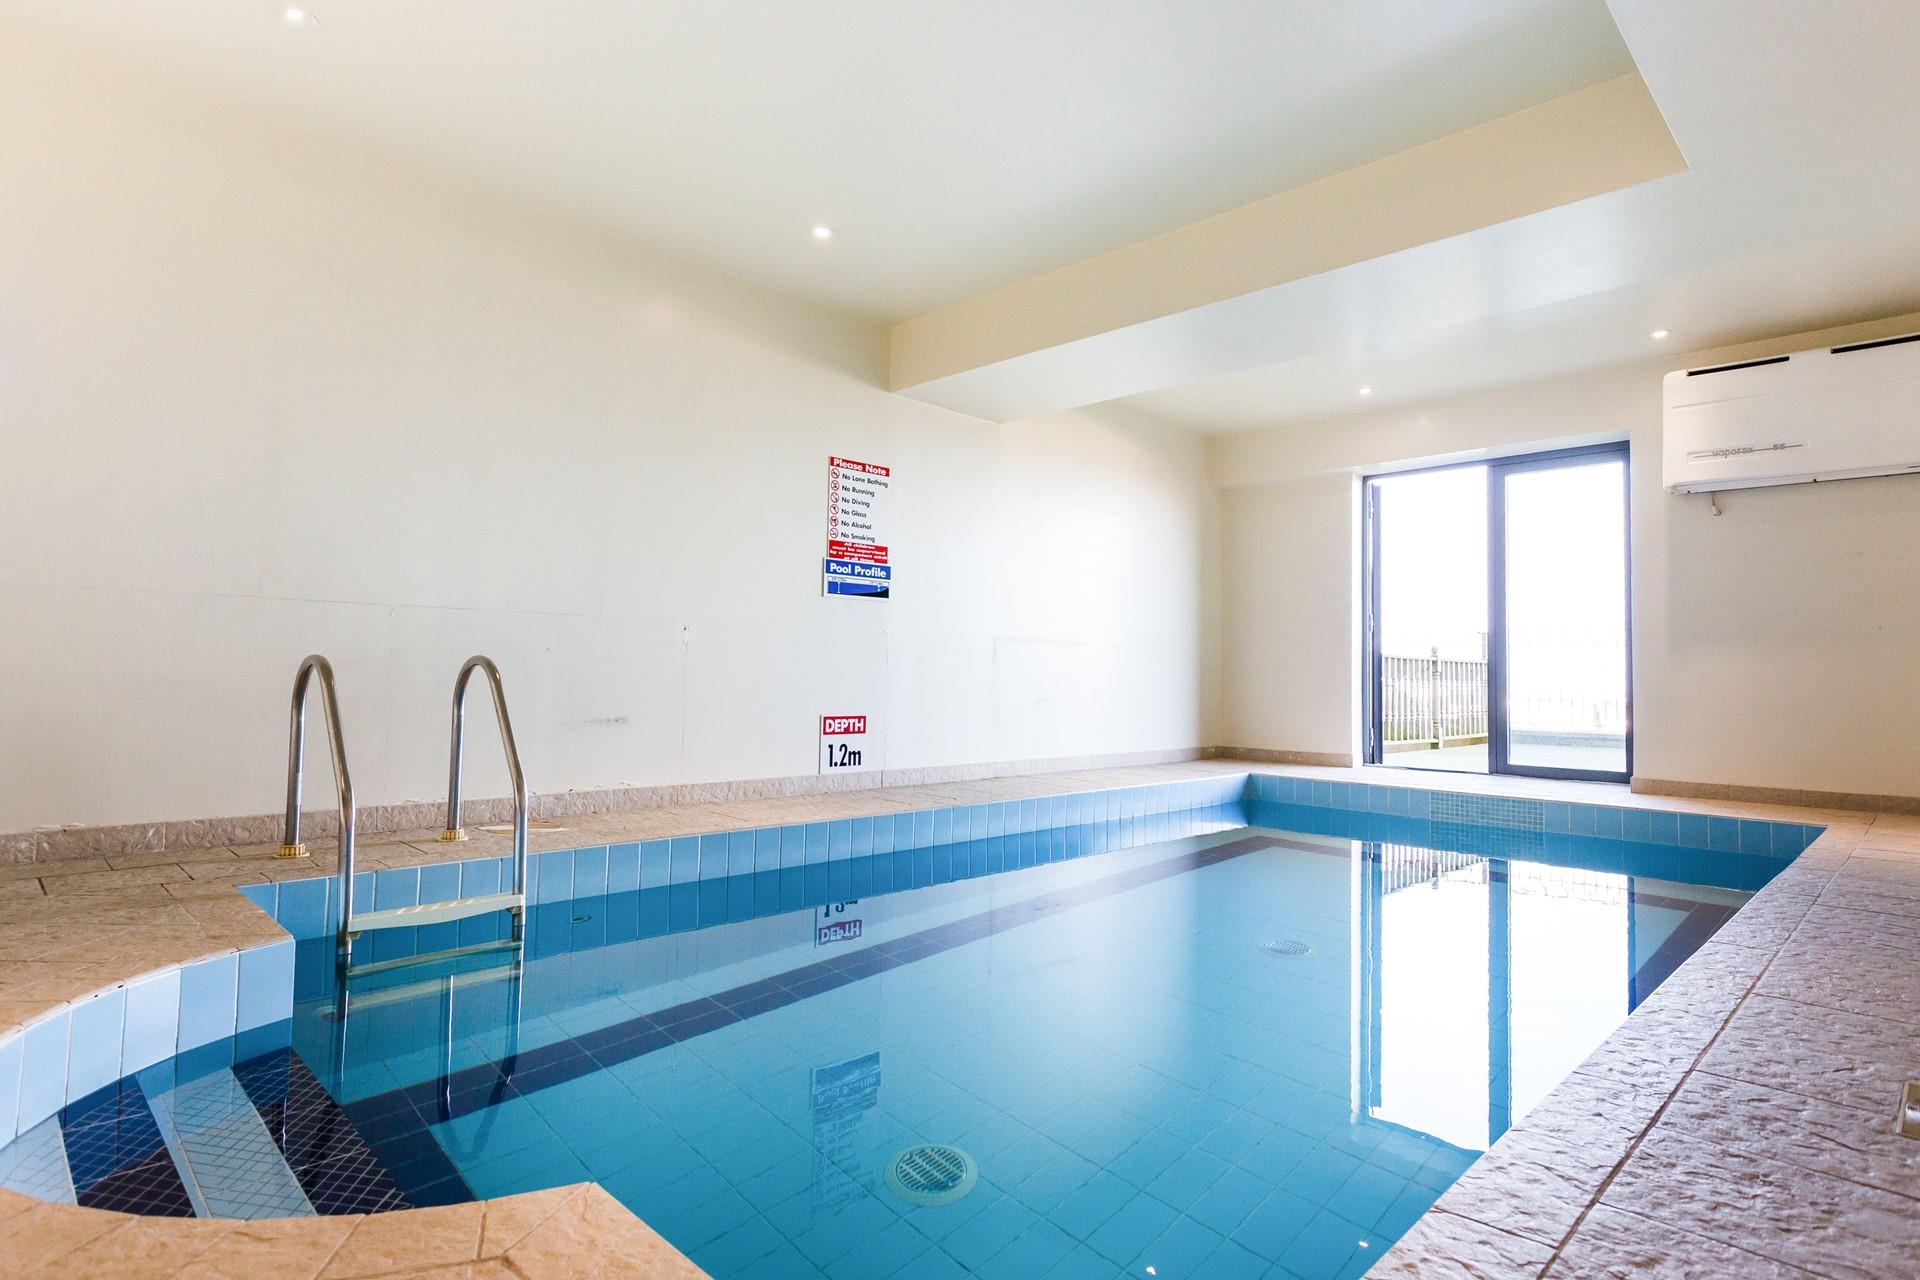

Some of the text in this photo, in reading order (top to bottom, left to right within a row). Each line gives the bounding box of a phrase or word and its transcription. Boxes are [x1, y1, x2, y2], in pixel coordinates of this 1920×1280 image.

[833, 458, 887, 476] Please Note
[841, 473, 889, 489] No Lone Bathing
[852, 486, 875, 498] Running
[851, 498, 870, 508] Diving
[841, 508, 867, 518] No Glass
[851, 521, 872, 530] Alcohol
[851, 533, 876, 544] Smoking
[829, 562, 887, 578] Pool Profile
[825, 718, 864, 733] DEPTH
[828, 743, 862, 767] 1.2m
